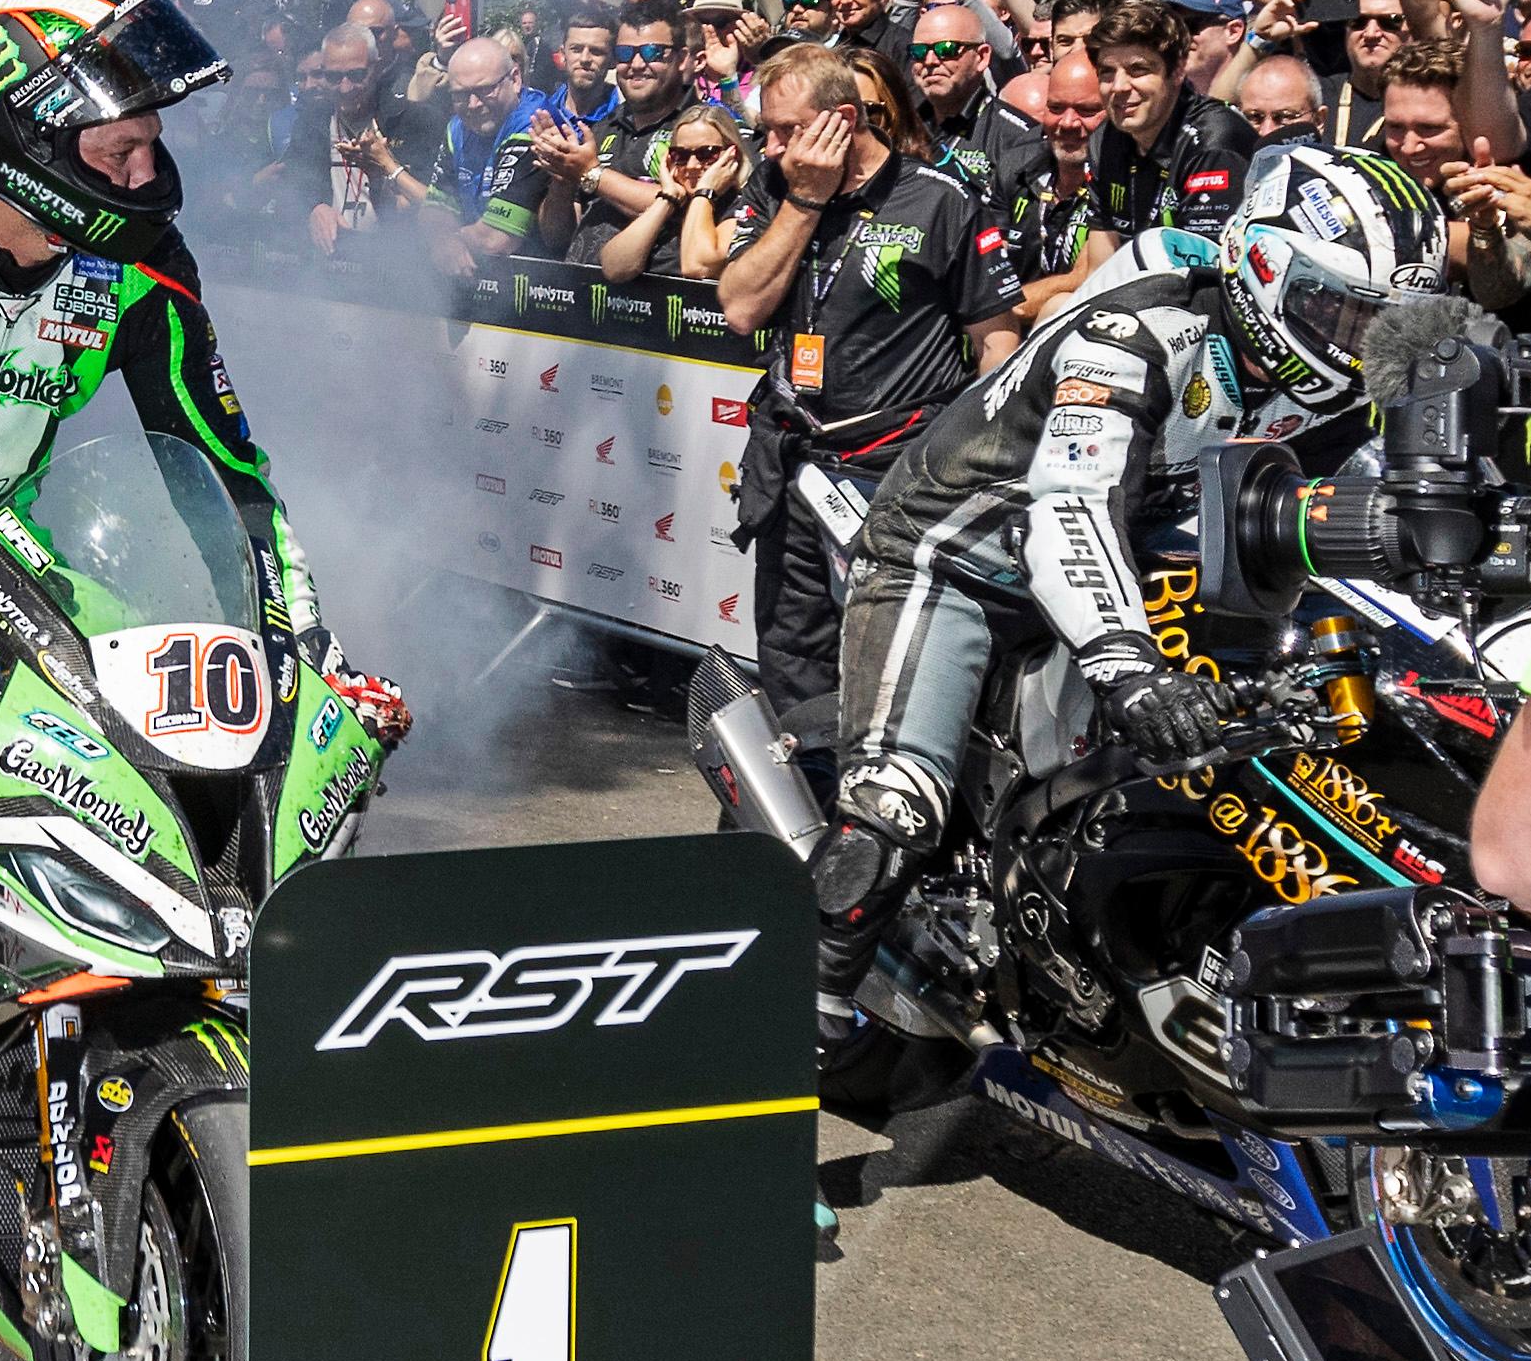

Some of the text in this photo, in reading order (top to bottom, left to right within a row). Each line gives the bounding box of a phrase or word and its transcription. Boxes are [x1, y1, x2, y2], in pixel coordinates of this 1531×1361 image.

[9, 66, 53, 104] BREMONT
[1189, 174, 1225, 189] MOTUL
[6, 180, 73, 225] ENERGY
[1303, 183, 1345, 239] JAMIESON
[1393, 267, 1439, 290] Arai
[528, 284, 576, 306] MONSTER
[606, 293, 652, 317] MONSTER
[535, 302, 569, 313] ENERGY
[681, 305, 728, 327] MONSTE
[689, 325, 725, 338] ENERGY
[590, 373, 624, 390] BREMONT
[475, 418, 509, 435] RST
[647, 446, 682, 466] BREMONT
[1046, 462, 1101, 472] ROADSIDE
[528, 488, 565, 507] RST
[531, 546, 561, 568] MOTUL
[262, 549, 280, 608] MONSTER
[586, 561, 625, 583] RST
[146, 634, 269, 736] 10
[299, 746, 374, 849] GasMonkey
[1311, 756, 1387, 826] 1886
[1209, 791, 1248, 835] @
[315, 929, 760, 1051] RST
[100, 1082, 132, 1107] sbs
[983, 1077, 1093, 1151] MOTUL
[49, 1080, 83, 1208] DUNLOP
